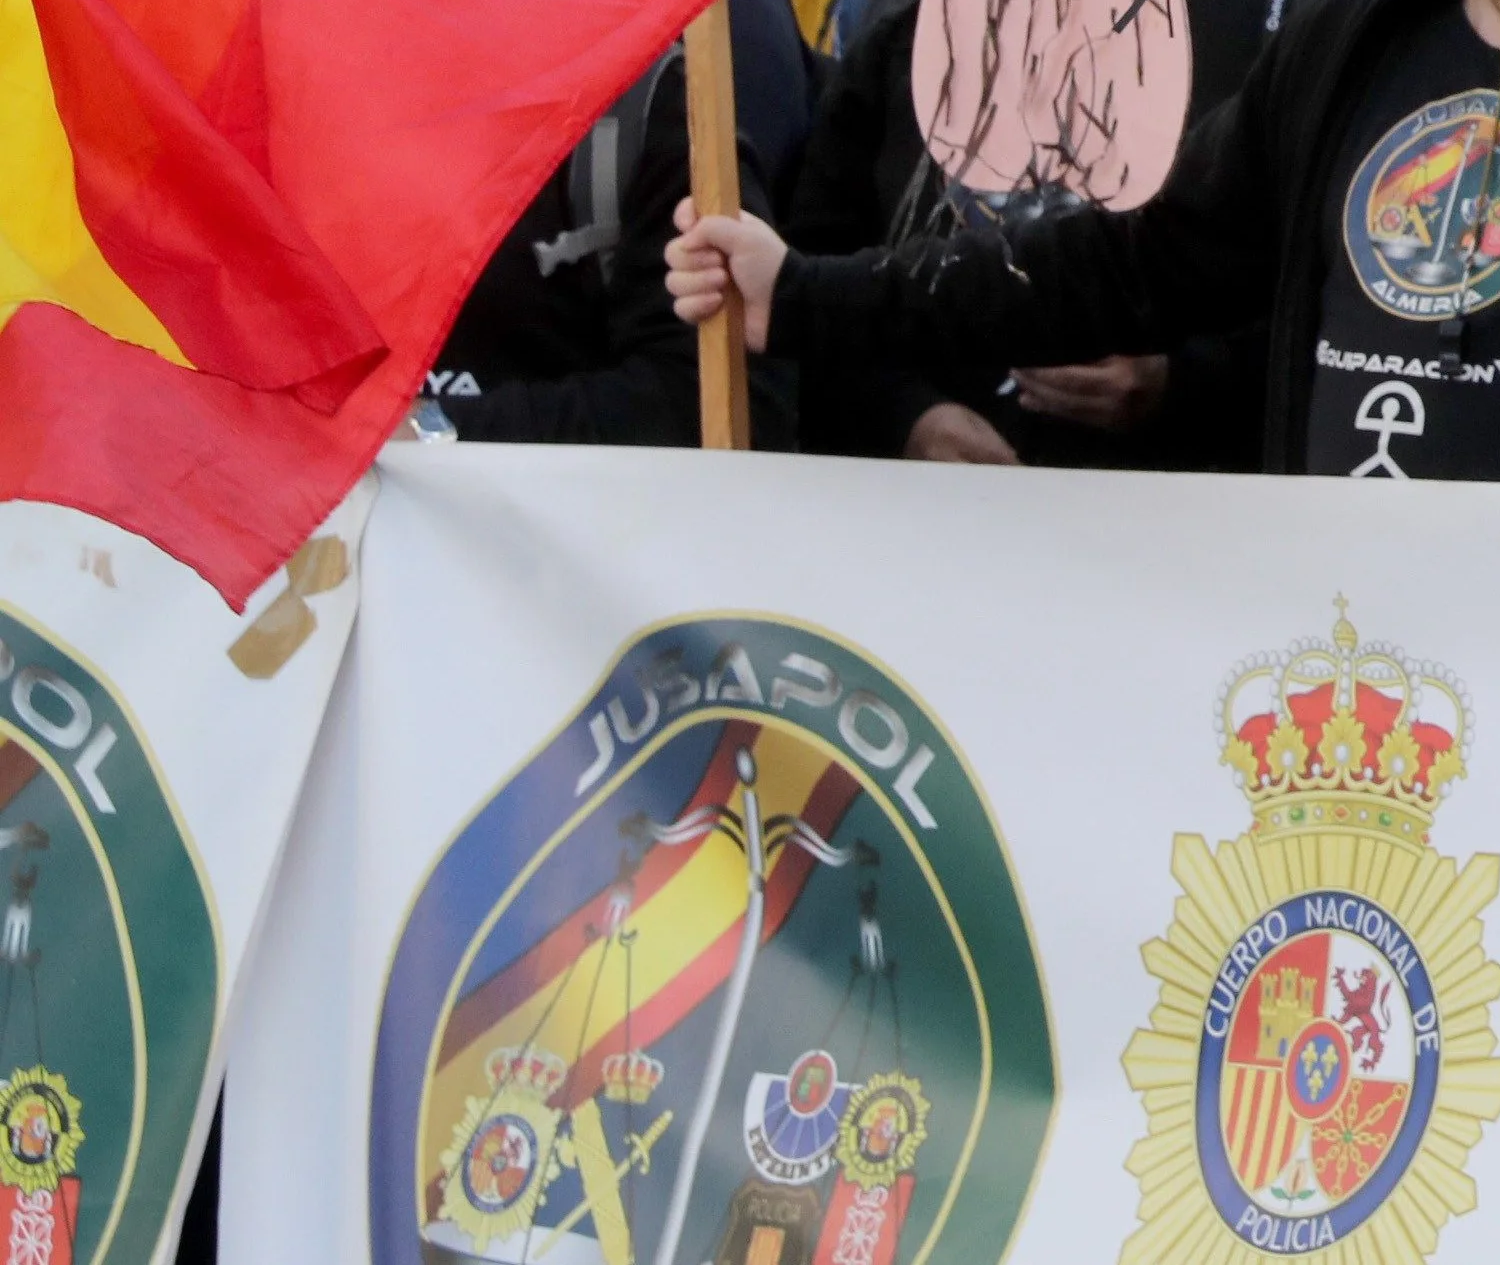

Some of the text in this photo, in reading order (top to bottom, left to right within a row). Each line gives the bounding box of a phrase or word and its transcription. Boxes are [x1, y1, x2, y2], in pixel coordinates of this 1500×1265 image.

[418, 369, 482, 396] YA
[0, 639, 117, 815] OL
[575, 641, 938, 830] JUSAPOL
[1205, 895, 1440, 1056] CUERPO NACIONAL DE
[1236, 1203, 1336, 1253] POLICIA
